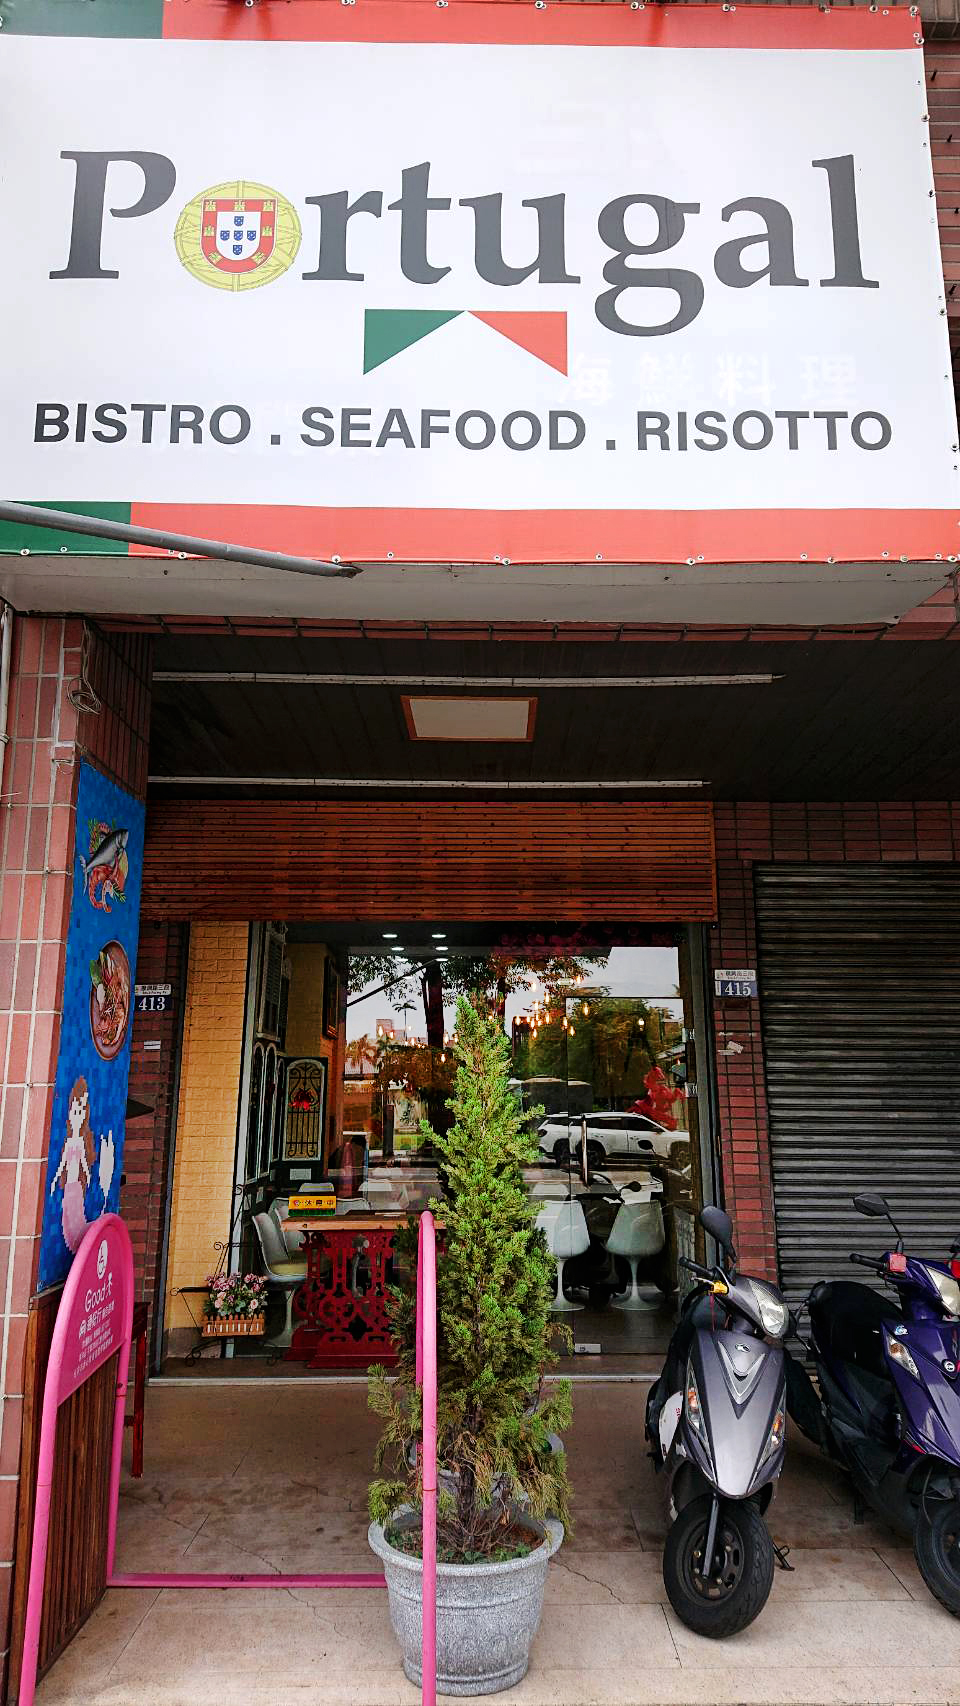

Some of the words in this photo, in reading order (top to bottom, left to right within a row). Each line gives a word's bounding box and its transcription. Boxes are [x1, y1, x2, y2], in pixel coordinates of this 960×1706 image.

[34, 403, 251, 444] BISTRO
[301, 407, 585, 451] SEAFOOD
[638, 410, 892, 451] RISOTTO
[725, 982, 751, 996] 415
[139, 997, 165, 1010] 413
[84, 1280, 106, 1313] Good
